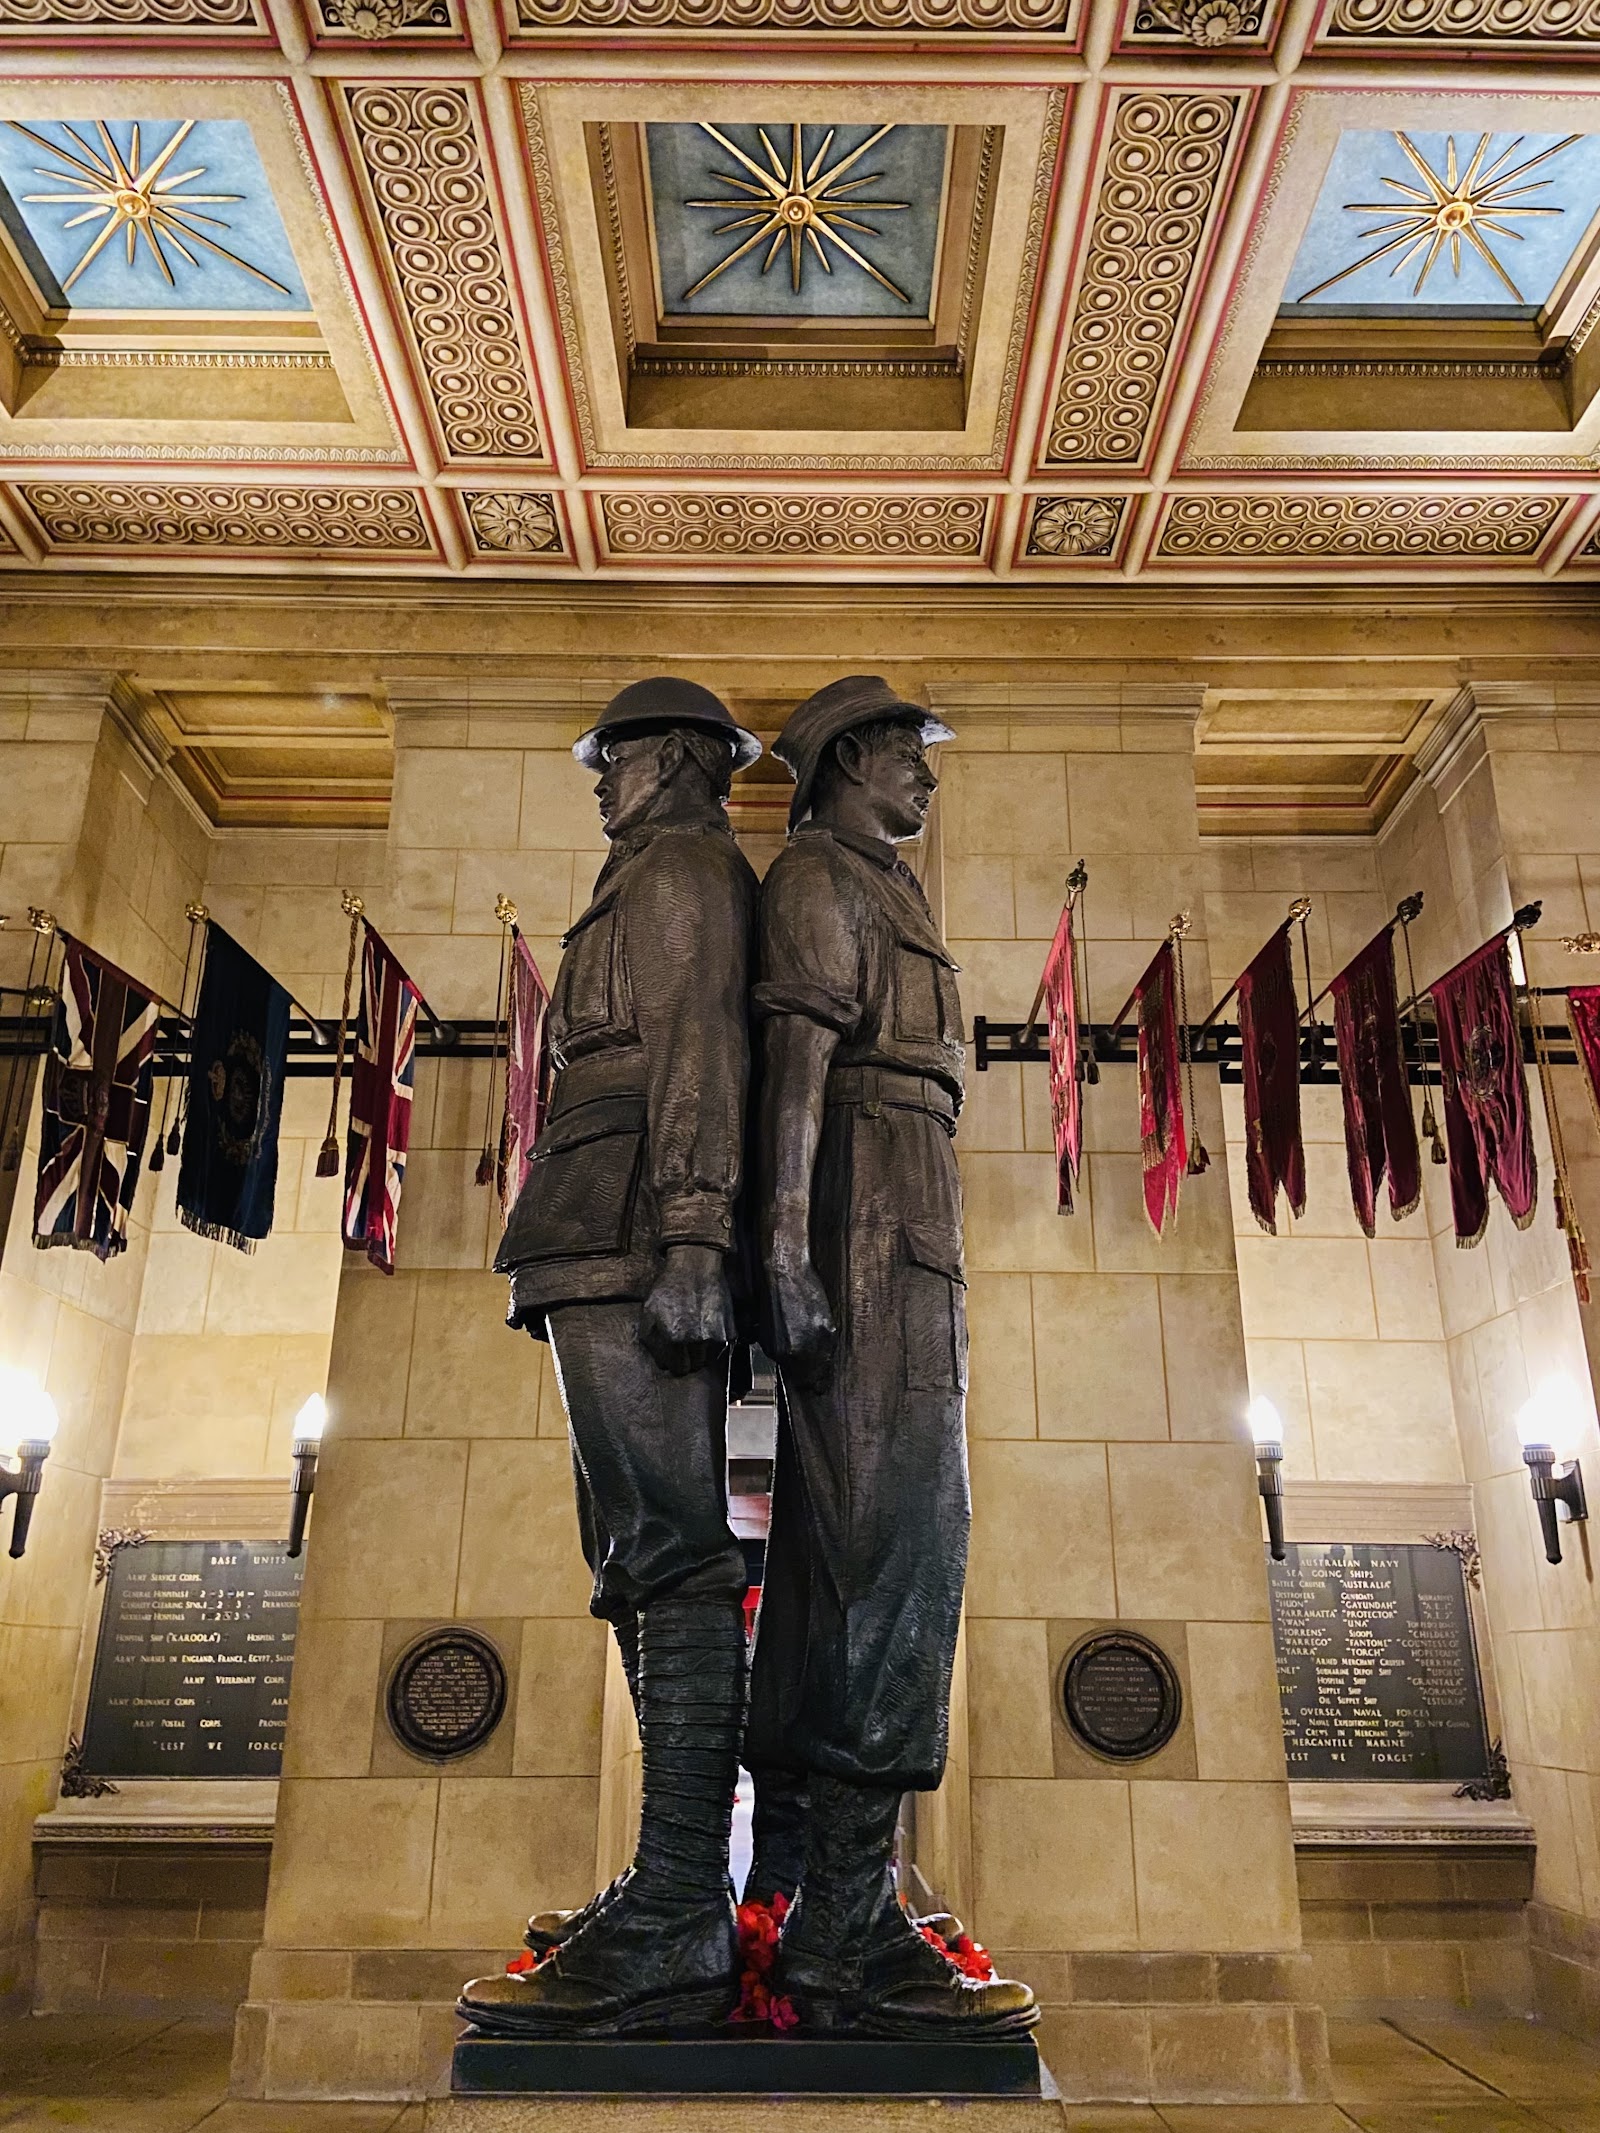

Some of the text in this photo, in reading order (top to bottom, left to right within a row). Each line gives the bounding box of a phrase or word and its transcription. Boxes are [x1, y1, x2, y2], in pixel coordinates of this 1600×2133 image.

[211, 1556, 286, 1565] BASE UNITS
[1300, 1559, 1360, 1567] AUSTRALIAN
[1371, 1560, 1399, 1568] NAVY
[1311, 1570, 1342, 1578] GOING
[1350, 1570, 1374, 1578] SHIPS
[200, 1590, 206, 1598] 2
[218, 1590, 224, 1598] 3
[1300, 1708, 1341, 1716] OVERSEA
[1353, 1709, 1382, 1717] NAVAL
[1292, 1739, 1405, 1747] MERCANTILE MARINE
[1331, 1753, 1346, 1761] WE
